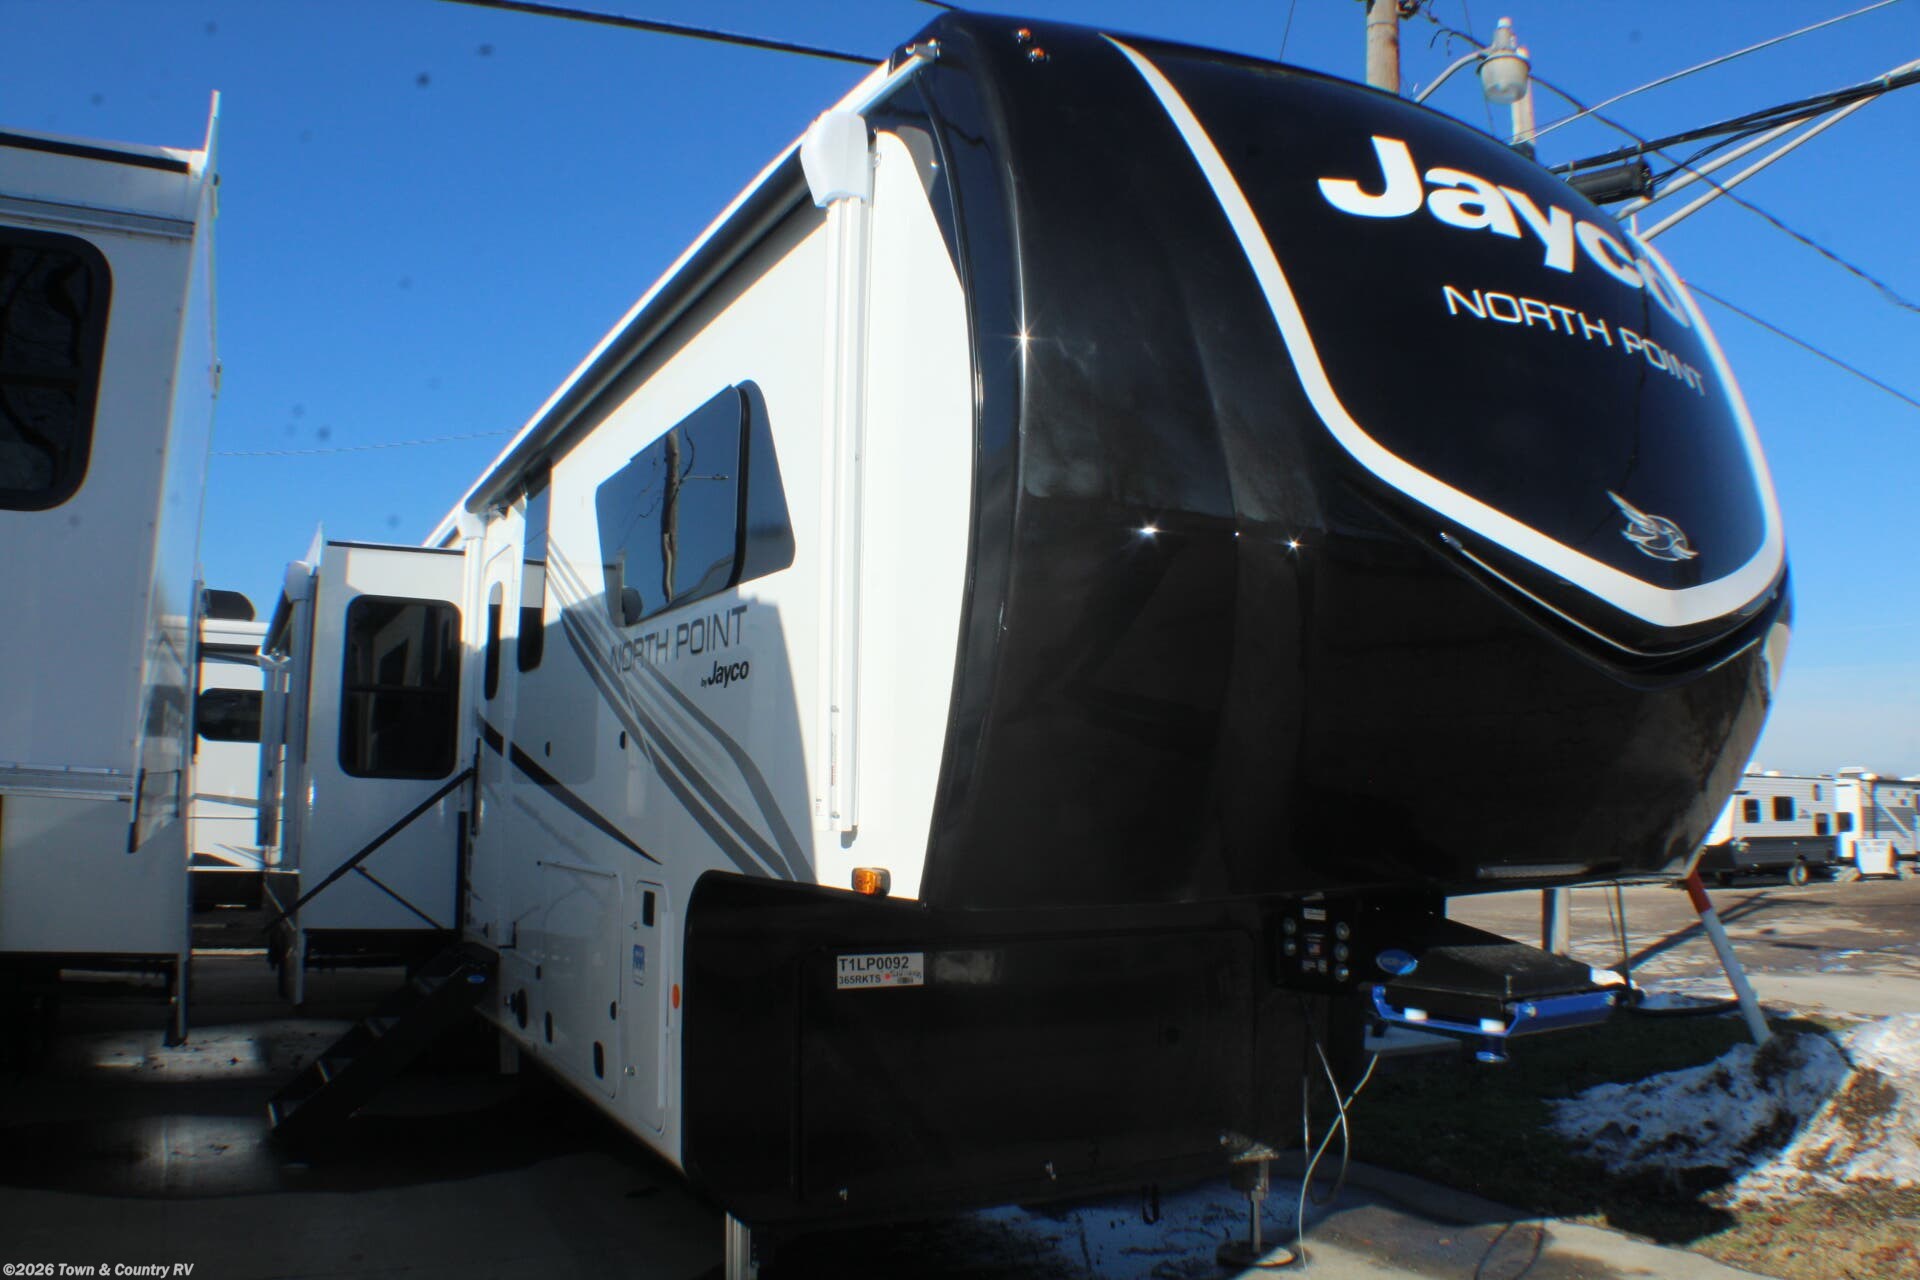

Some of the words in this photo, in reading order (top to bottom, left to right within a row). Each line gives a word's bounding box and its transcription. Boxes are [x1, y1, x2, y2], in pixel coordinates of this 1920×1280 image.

[1318, 136, 1691, 328] Jayco
[1442, 286, 1612, 346] NORTH
[1619, 327, 1704, 396] POINT
[611, 629, 669, 674] NORTH
[676, 605, 748, 660] POINT
[707, 661, 749, 688] Jayco
[839, 956, 909, 972] T1LP0092
[839, 975, 882, 985] 365RKTS
